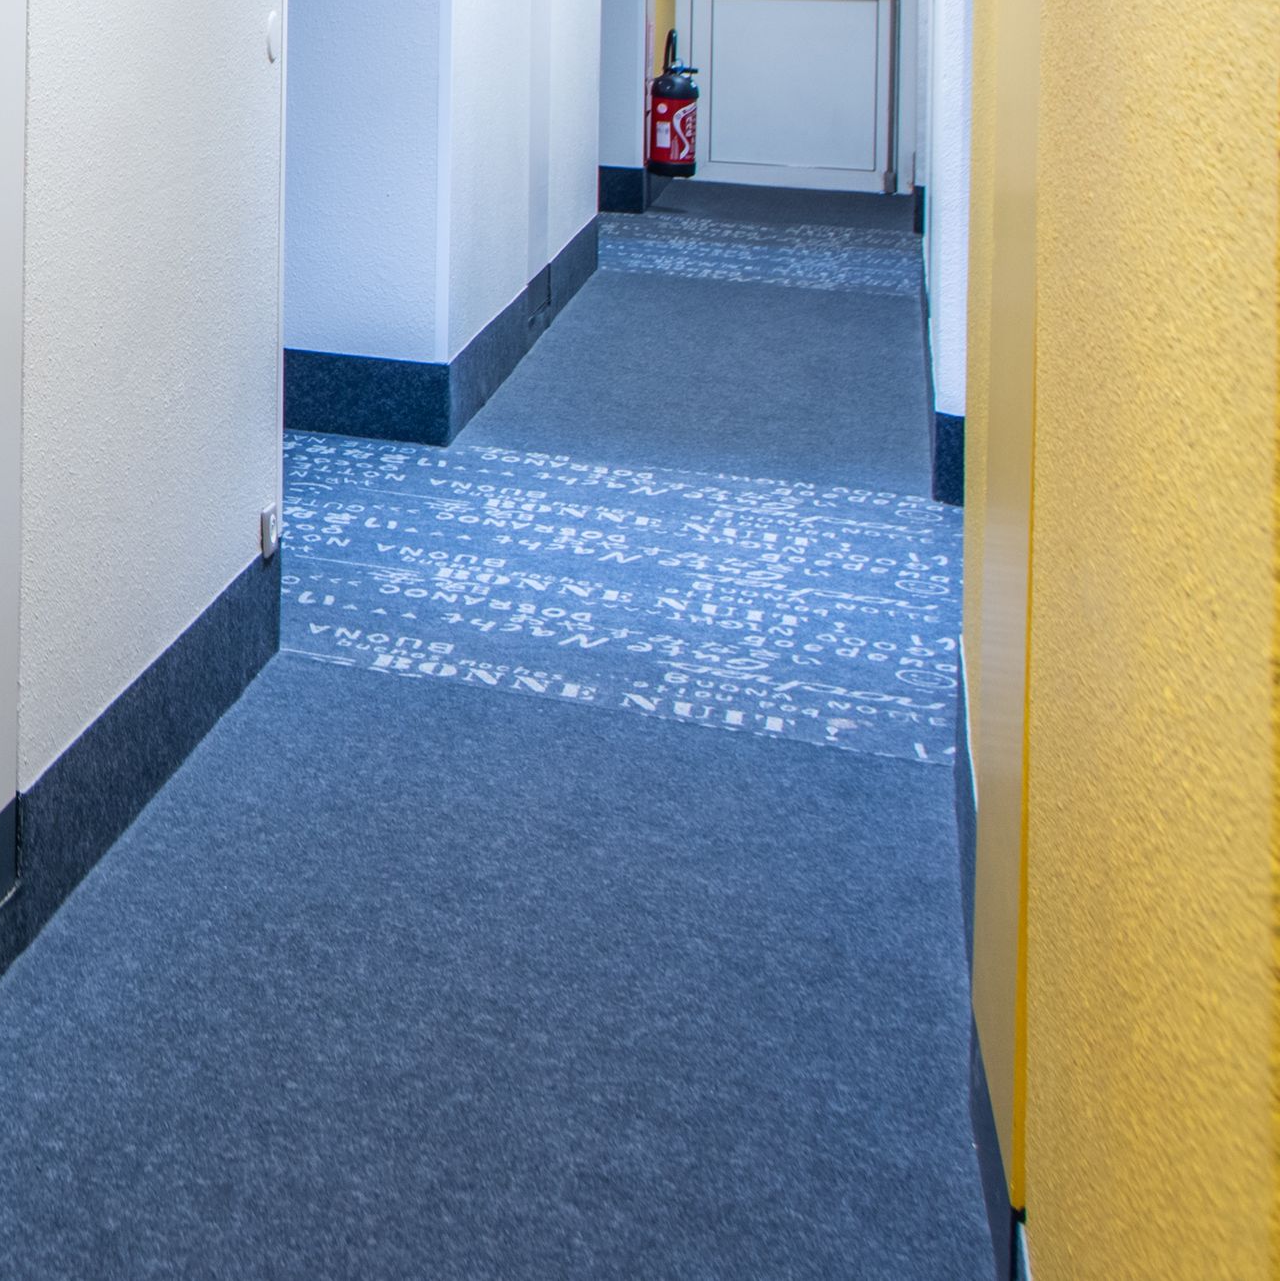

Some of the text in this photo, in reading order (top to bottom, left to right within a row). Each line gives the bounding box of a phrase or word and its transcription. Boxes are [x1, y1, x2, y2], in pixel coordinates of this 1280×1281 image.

[379, 581, 592, 626] DOBRANOC
[436, 563, 632, 602] BONNE
[654, 597, 808, 626] NUIT
[441, 613, 609, 648] Nacht
[373, 651, 596, 701] BONNE
[620, 693, 795, 732] NUIT
